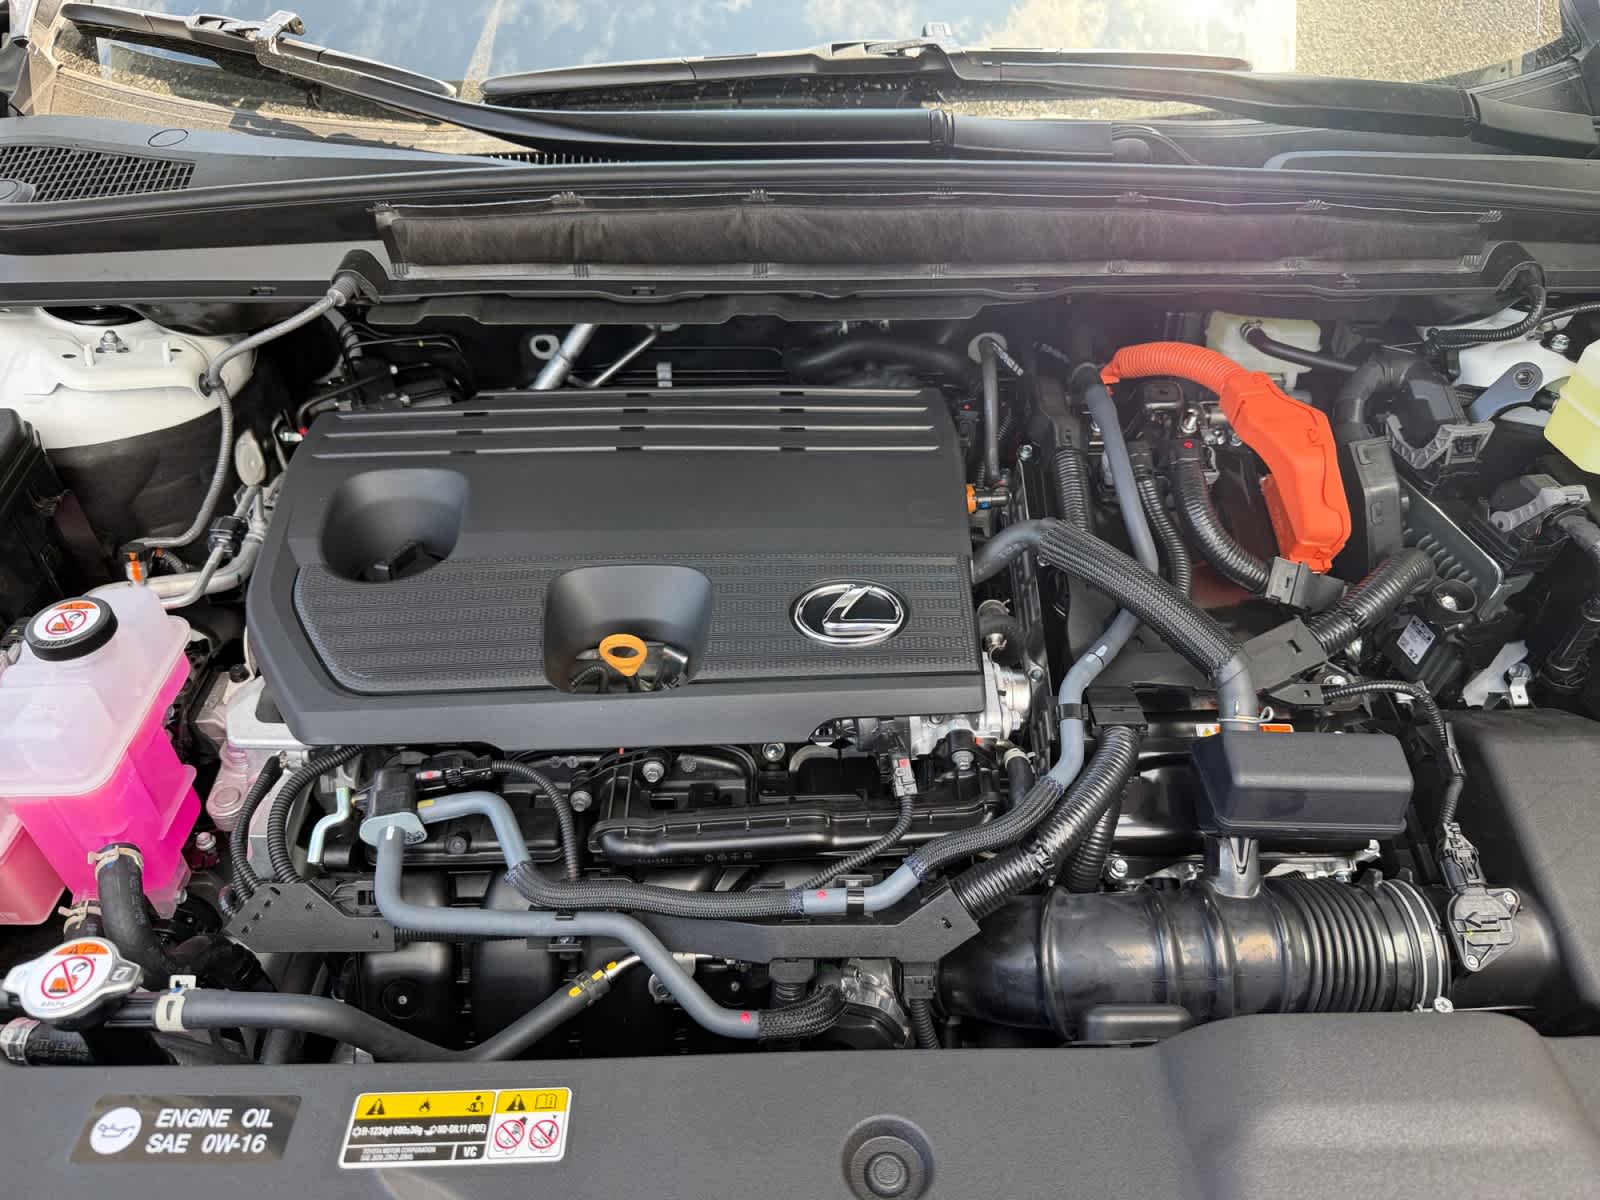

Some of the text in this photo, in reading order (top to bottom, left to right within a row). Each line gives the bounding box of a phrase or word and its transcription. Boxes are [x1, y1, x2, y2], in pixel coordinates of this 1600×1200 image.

[155, 1108, 274, 1128] ENGINE OIL
[145, 1132, 268, 1153] SAE 0W-16
